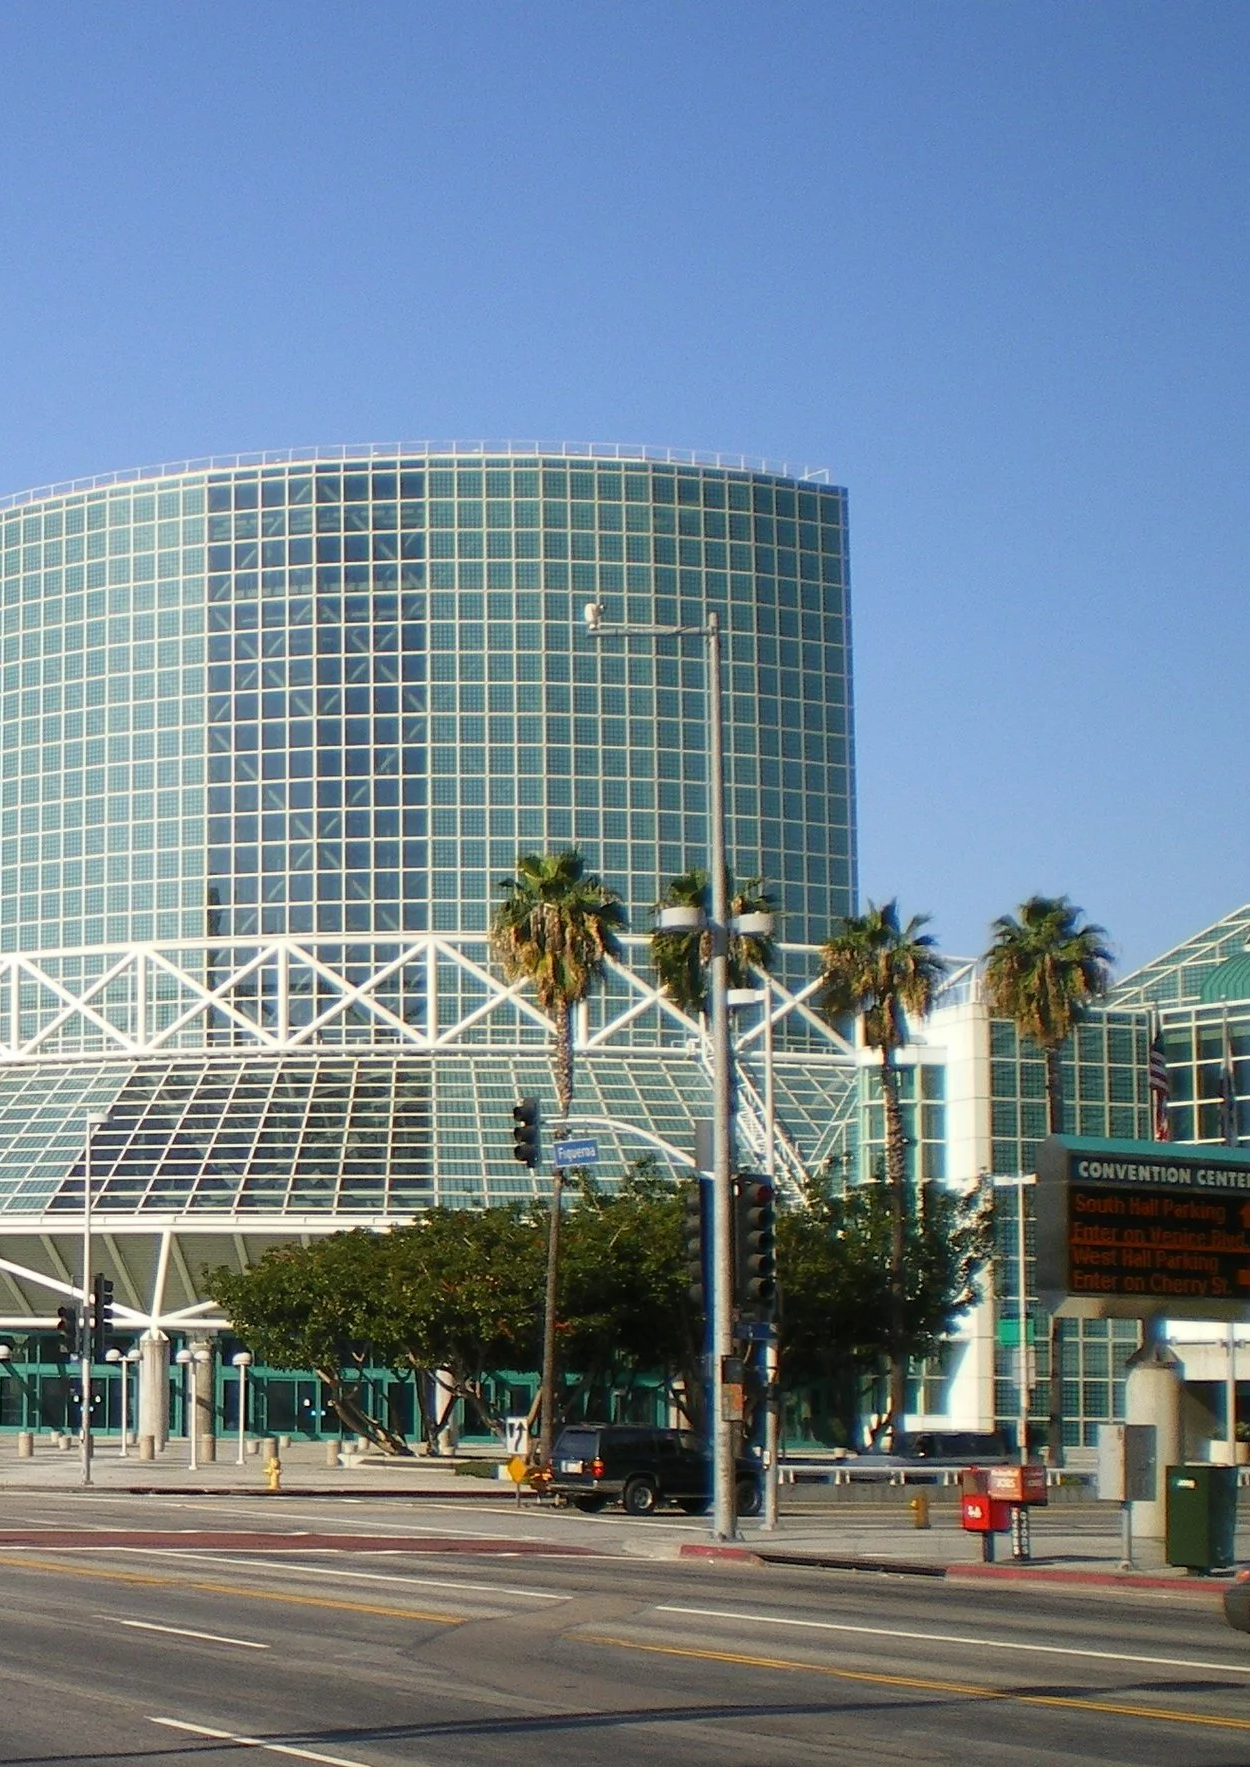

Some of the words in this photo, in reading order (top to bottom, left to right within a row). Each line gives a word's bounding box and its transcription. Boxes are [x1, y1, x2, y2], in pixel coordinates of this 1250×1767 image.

[1078, 1160, 1192, 1184] CONVENTION
[1075, 1193, 1125, 1214] South
[1129, 1197, 1159, 1216] Hall
[1163, 1199, 1226, 1225] Parking
[1073, 1222, 1117, 1242] Enter
[1124, 1229, 1146, 1243] on
[1151, 1227, 1207, 1246] Venice
[1073, 1246, 1118, 1266] West
[1123, 1248, 1151, 1268] Hall
[1156, 1250, 1219, 1275] Parking
[1073, 1269, 1119, 1289] Enter
[1124, 1276, 1145, 1291] on
[1151, 1273, 1208, 1295] Cherry
[1211, 1276, 1232, 1295] St.
